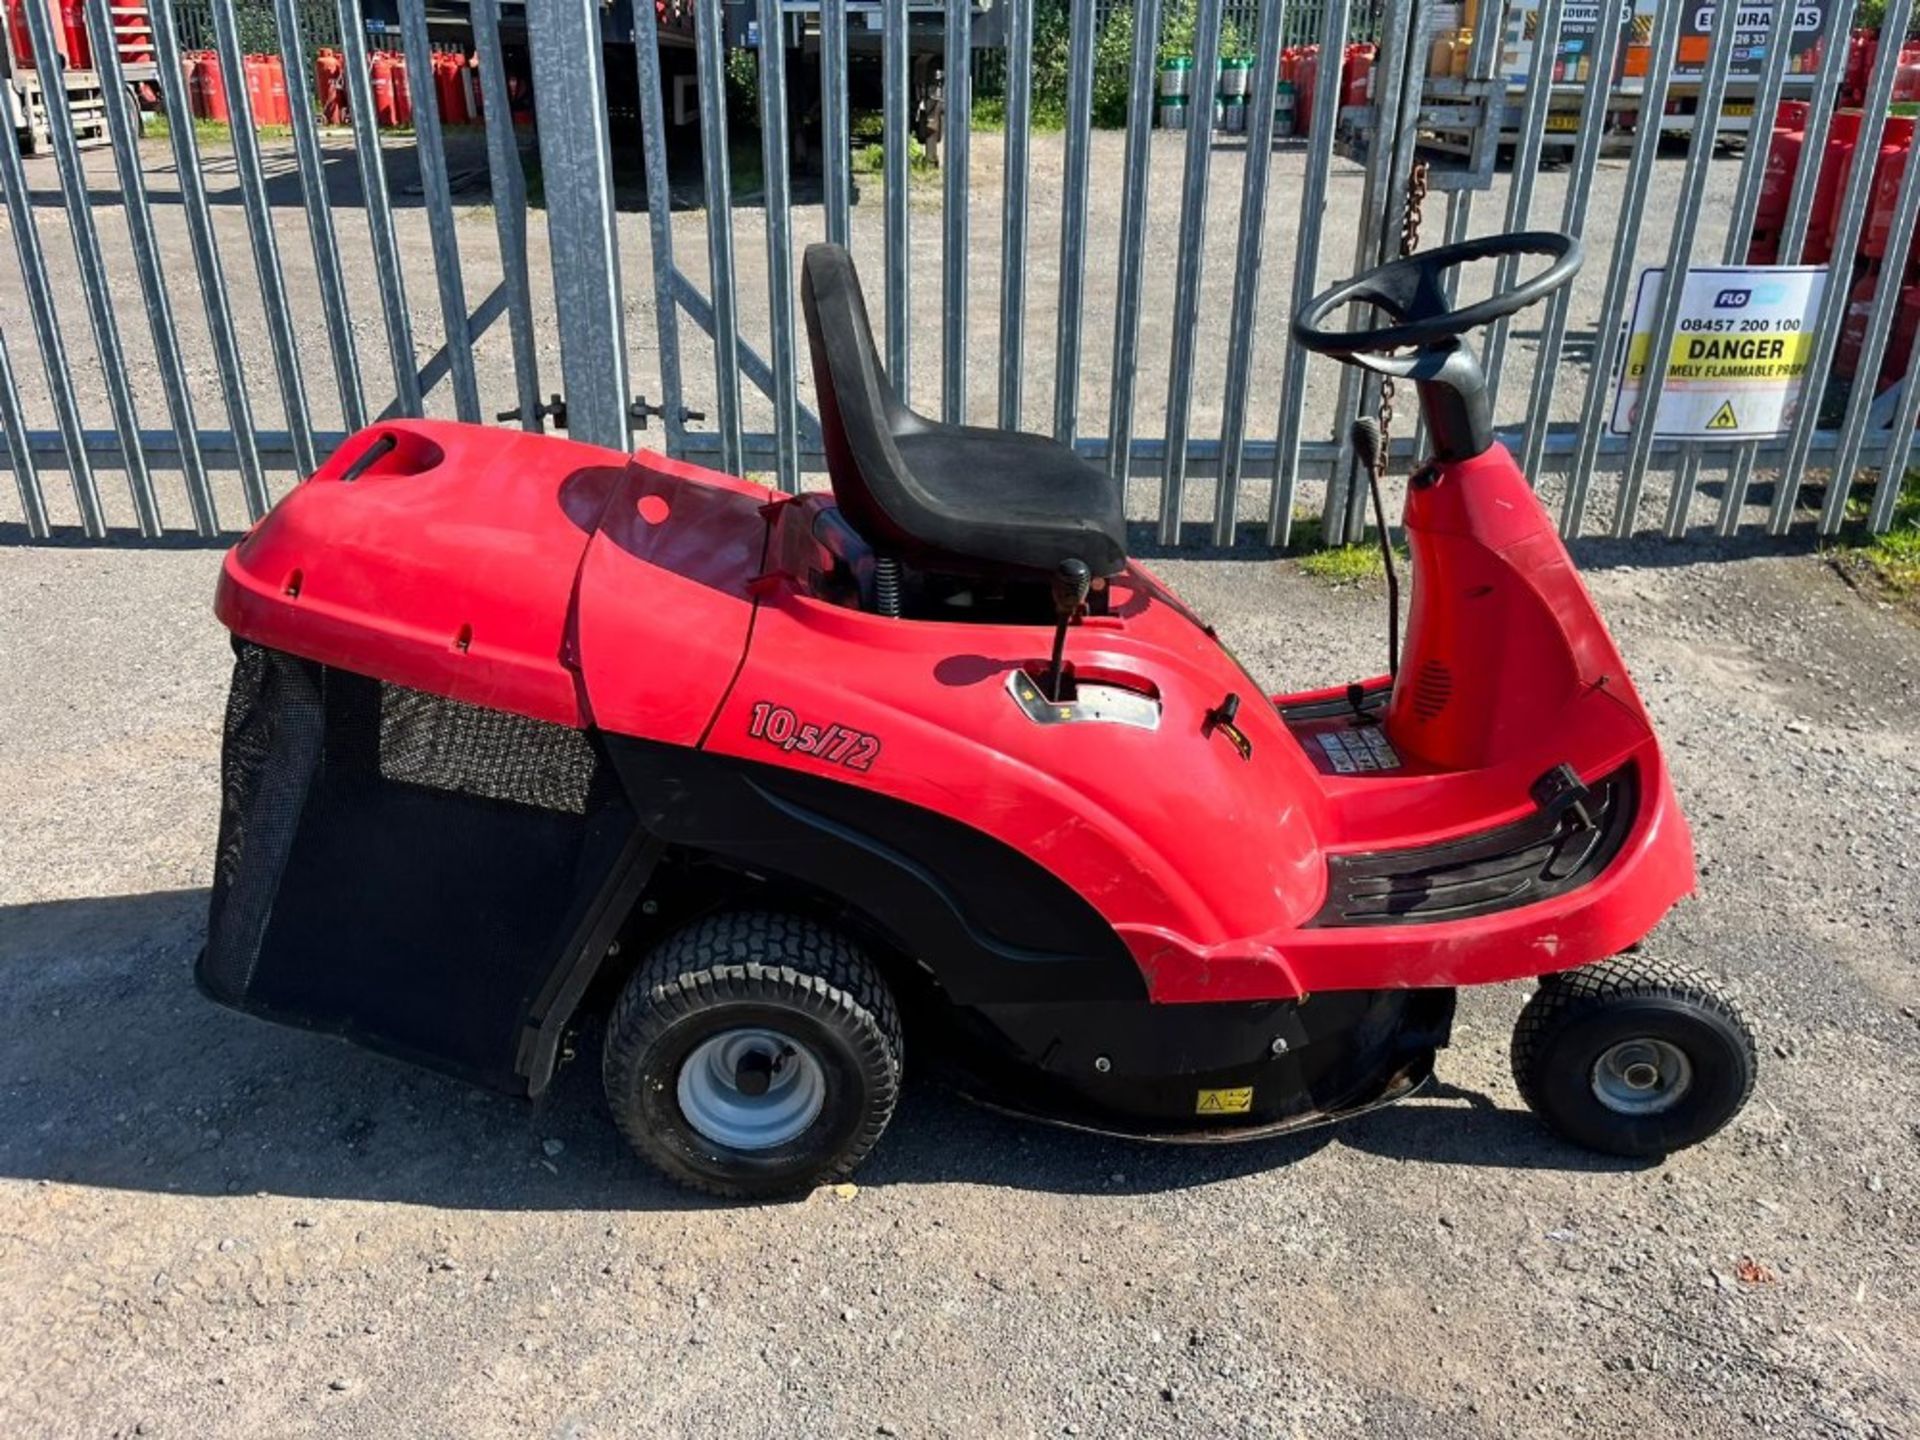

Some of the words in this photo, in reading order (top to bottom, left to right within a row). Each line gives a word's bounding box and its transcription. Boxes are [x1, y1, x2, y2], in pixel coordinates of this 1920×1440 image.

[1700, 12, 1818, 26] EURAAS
[1720, 293, 1746, 304] FLO
[1681, 319, 1735, 331] 08457
[1740, 319, 1770, 331] 200
[1776, 319, 1801, 331] 100
[1688, 339, 1785, 359] DANGER
[1632, 364, 1702, 377] EXMELY
[1704, 364, 1774, 377] FLAMMABLE
[750, 701, 881, 772] 10,5/72
